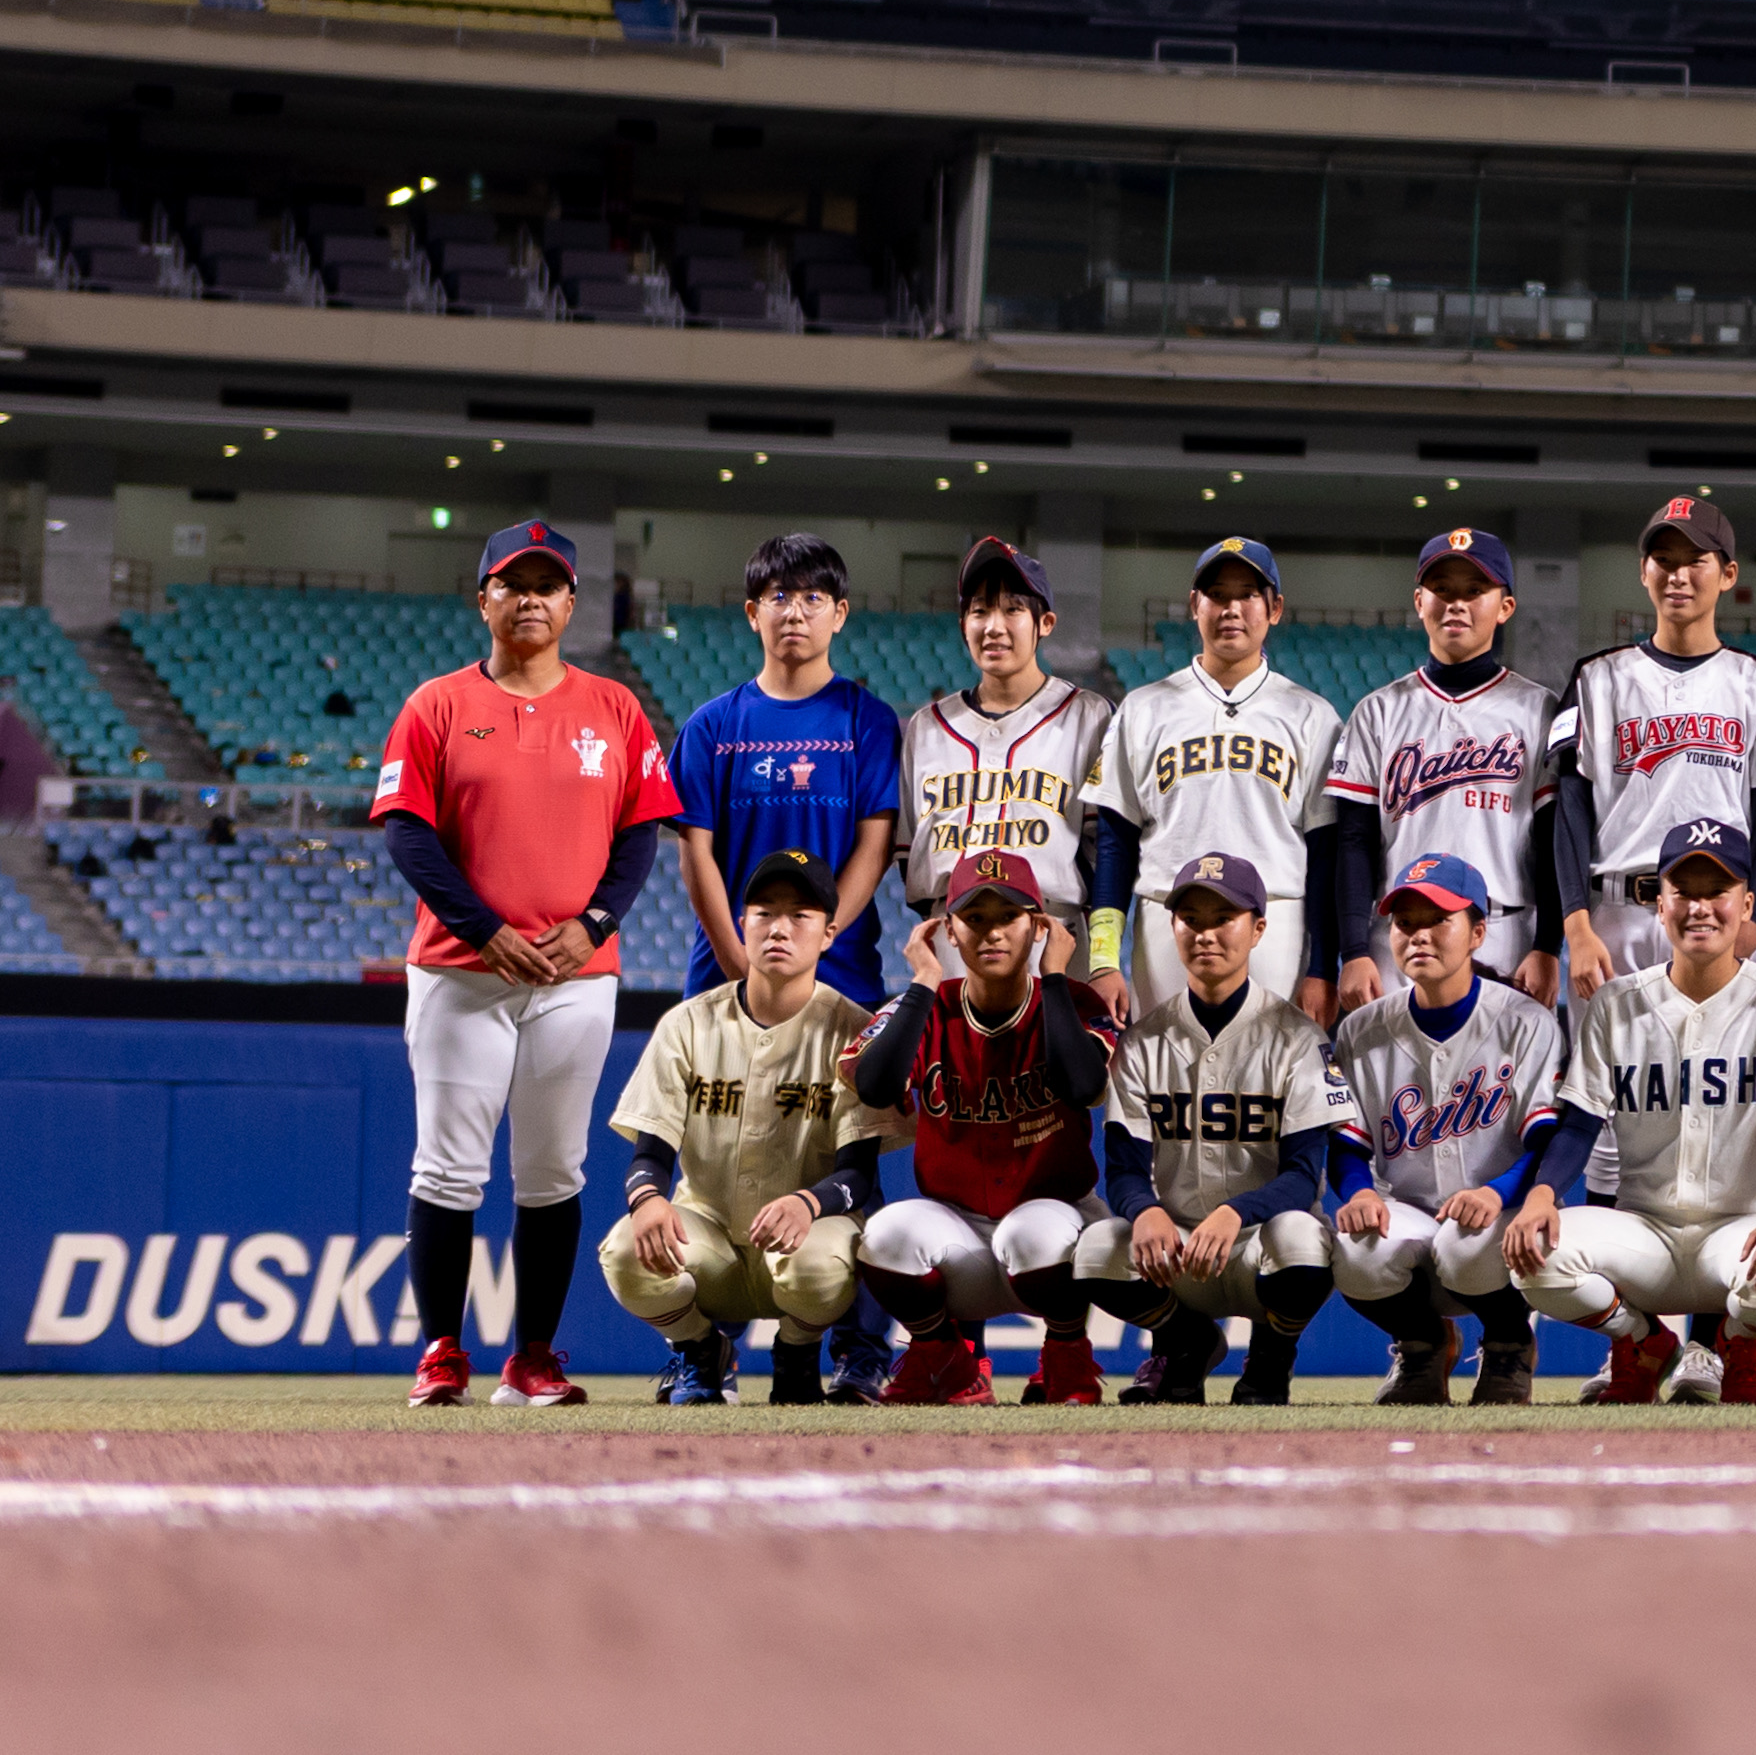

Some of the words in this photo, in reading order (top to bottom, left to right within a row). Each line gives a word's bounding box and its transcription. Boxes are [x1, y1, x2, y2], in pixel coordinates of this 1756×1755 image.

[1664, 498, 1694, 520] H
[1615, 713, 1745, 762] HAYATO
[1156, 734, 1297, 802] SEISEI
[1383, 733, 1527, 816] Daiichi
[1686, 751, 1743, 773] YOKOHAMA
[921, 768, 1073, 821] SHUMEI
[1464, 789, 1514, 815] GIFU
[932, 819, 1050, 853] YACHIYO
[1194, 857, 1224, 880] R
[1380, 1064, 1514, 1159] Seibi
